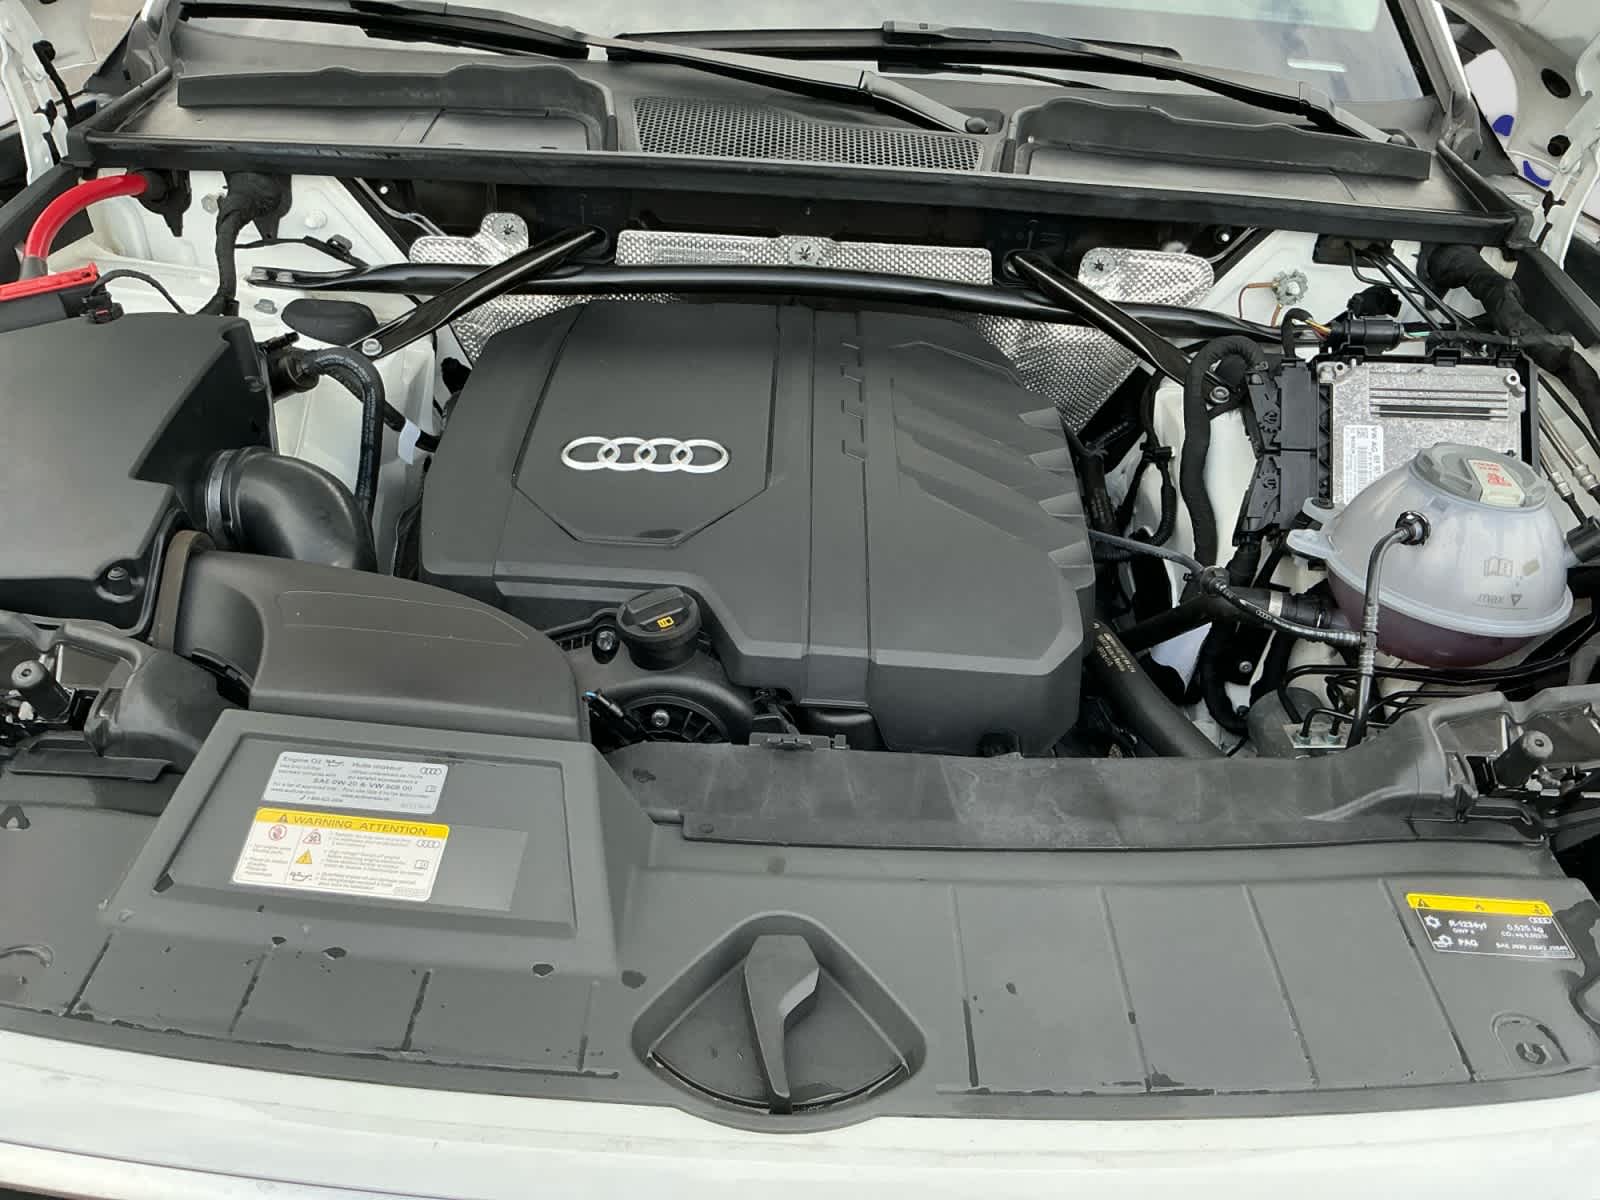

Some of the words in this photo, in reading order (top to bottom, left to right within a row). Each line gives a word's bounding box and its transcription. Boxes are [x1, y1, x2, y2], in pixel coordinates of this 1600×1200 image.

[1478, 593, 1505, 604] max
[368, 782, 384, 790] VW
[294, 815, 352, 829] WARNING
[360, 822, 429, 836] ATTENTION
